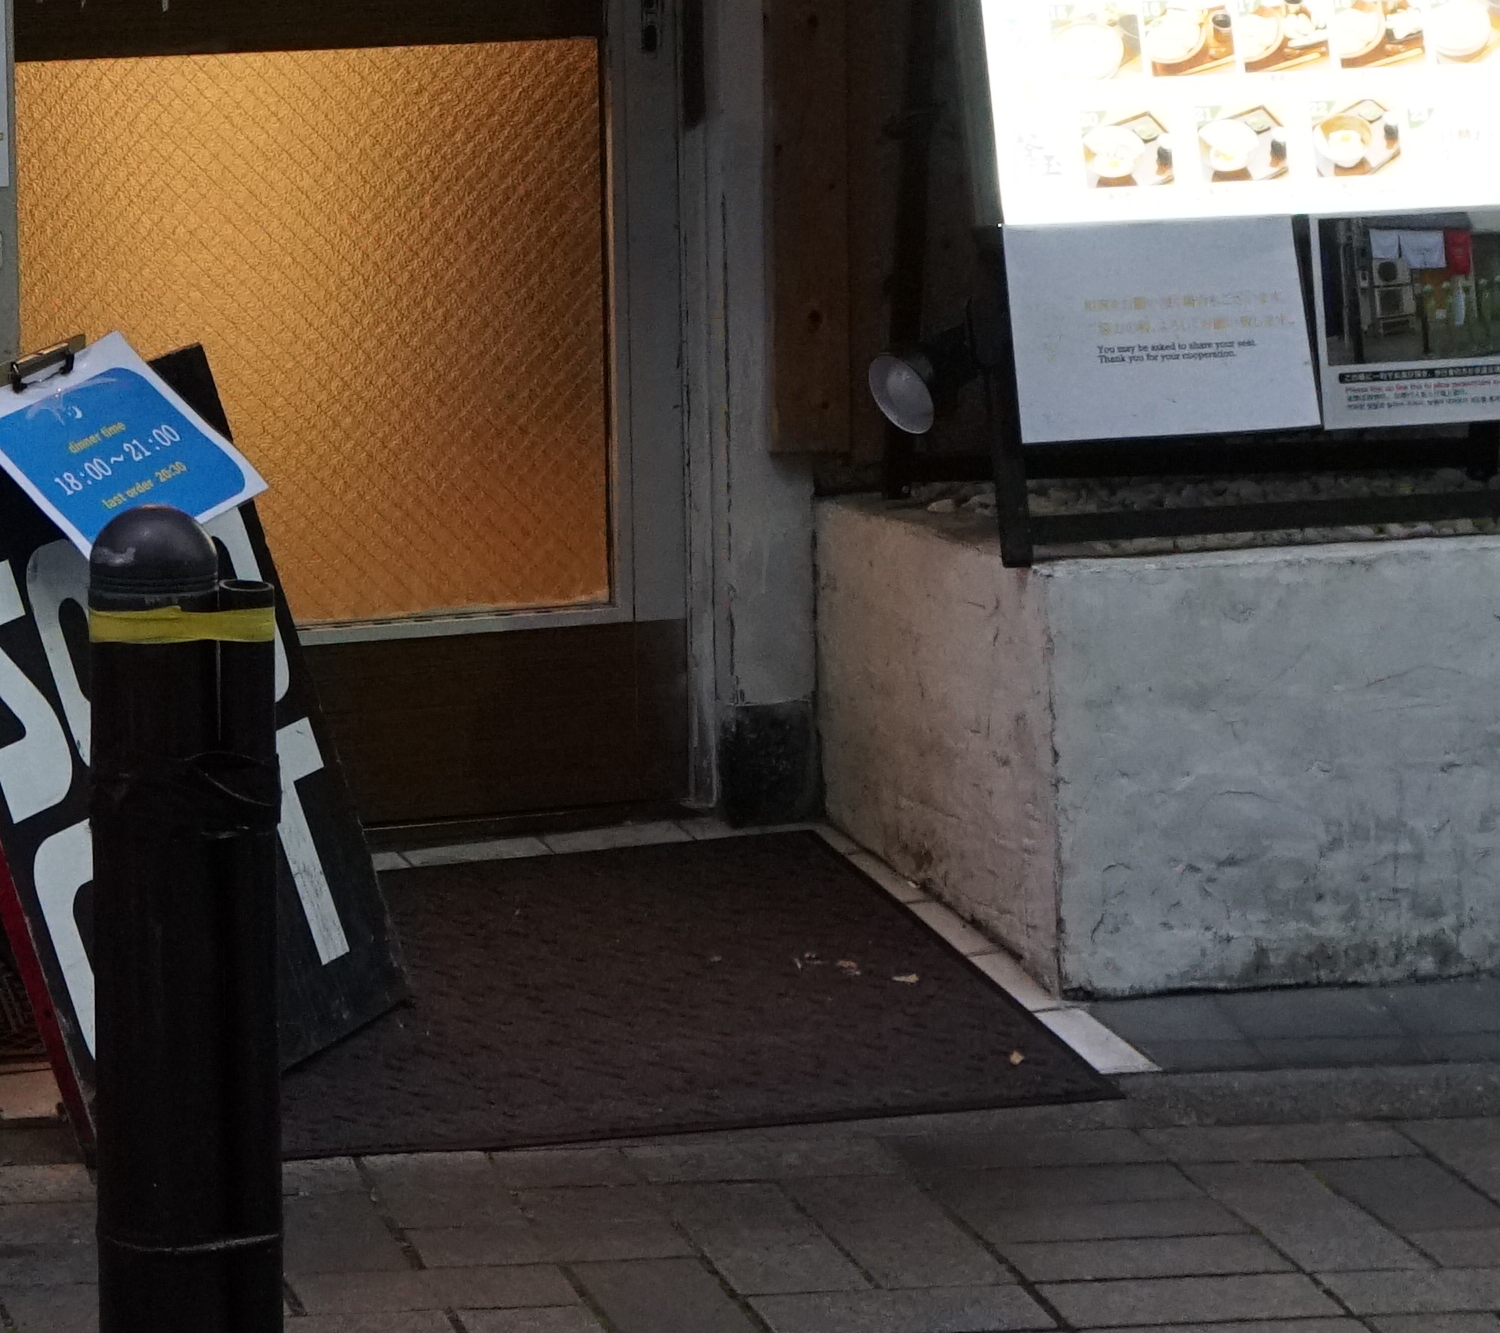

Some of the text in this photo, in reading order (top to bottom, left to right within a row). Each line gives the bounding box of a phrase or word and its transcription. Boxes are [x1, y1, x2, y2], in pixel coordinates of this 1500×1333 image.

[1097, 345, 1115, 354] You
[1117, 344, 1135, 355] may
[1138, 343, 1149, 352] be
[1151, 342, 1176, 352] asked
[1178, 342, 1187, 351] to
[1189, 340, 1213, 350] share
[1215, 341, 1235, 350] your
[1098, 353, 1126, 364] Thank
[1127, 354, 1144, 365] you
[1146, 351, 1159, 361] for
[1160, 352, 1181, 363] your
[67, 420, 127, 455] dinner time
[102, 460, 188, 511] last order 20:30
